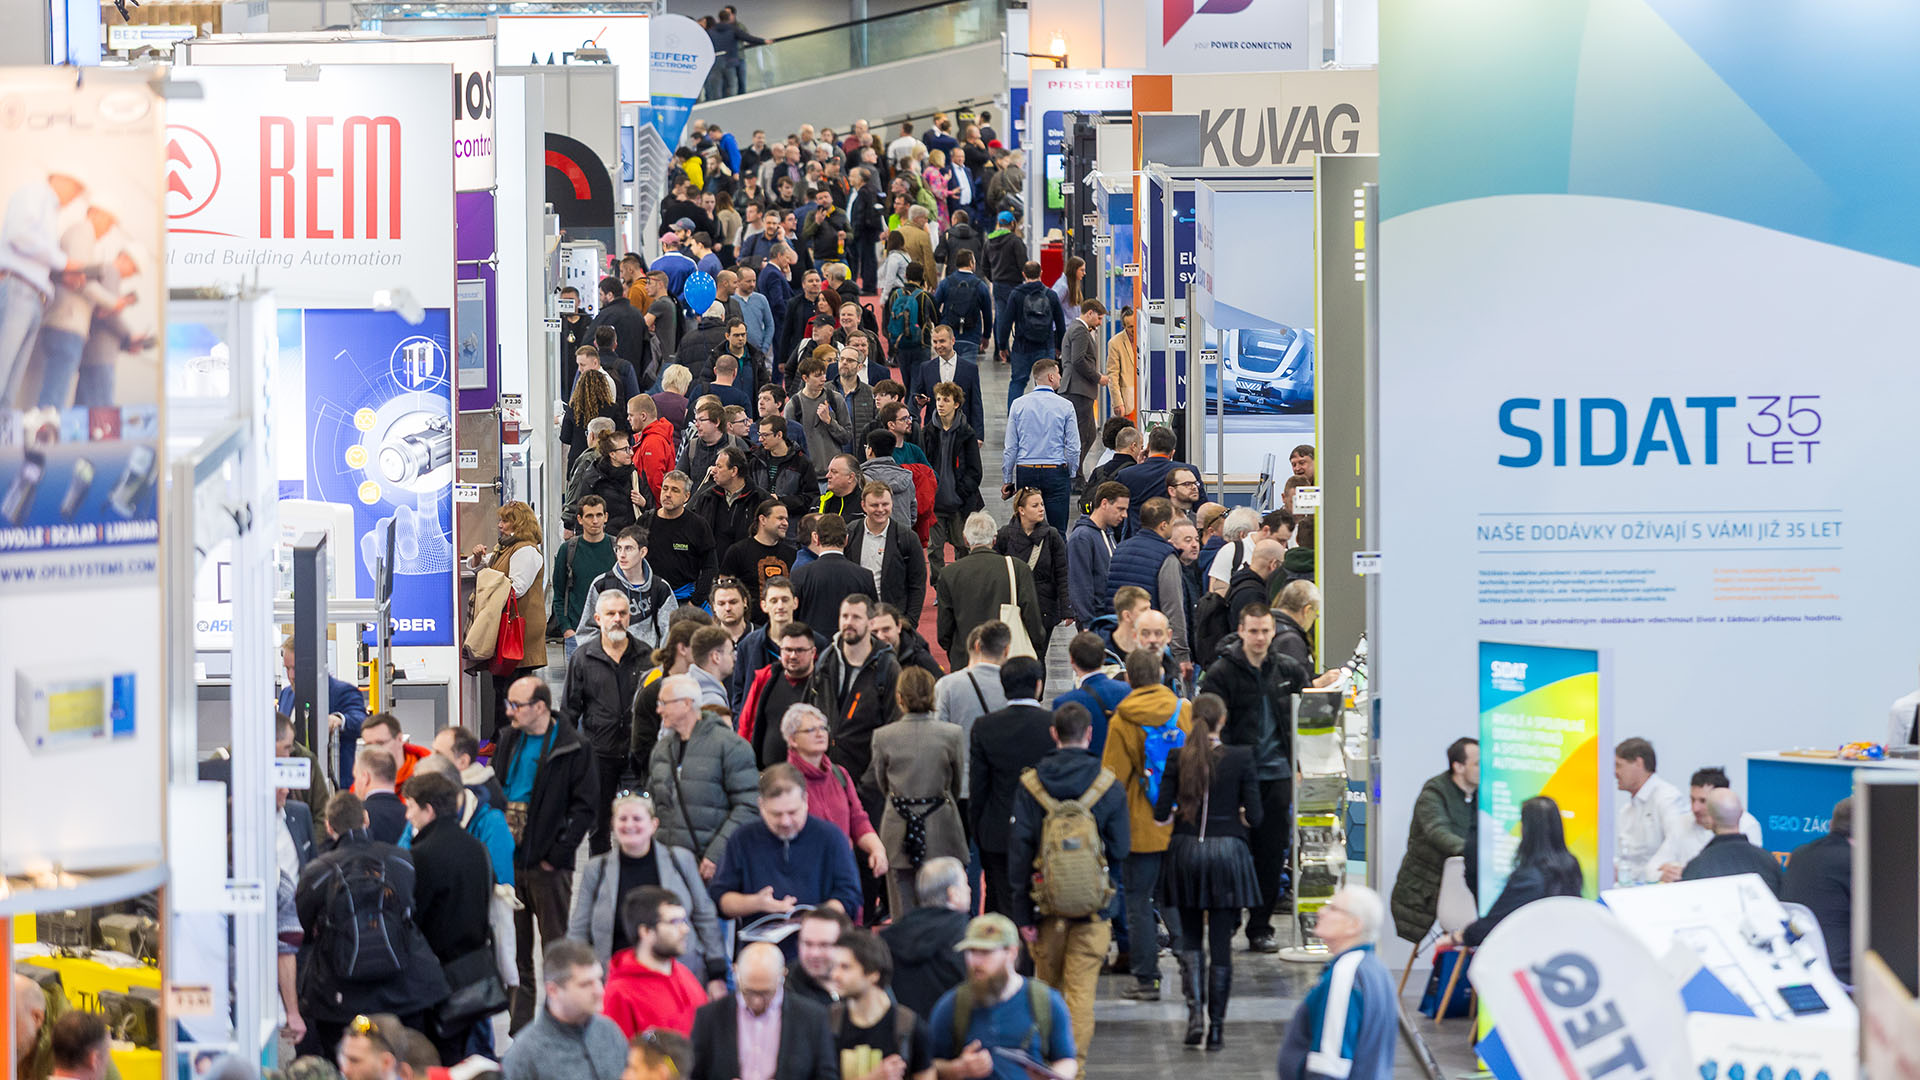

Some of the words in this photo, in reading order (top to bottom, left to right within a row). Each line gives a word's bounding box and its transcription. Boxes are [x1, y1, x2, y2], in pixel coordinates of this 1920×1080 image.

[1210, 41, 1239, 49] POWER
[1240, 41, 1292, 50] CONNECTION
[1200, 103, 1360, 167] KUVAG
[260, 116, 401, 239] REM
[184, 249, 216, 265] and
[222, 248, 294, 269] Building
[300, 250, 402, 266] Automation
[1498, 396, 1737, 468] SIDAT
[1747, 395, 1822, 437] 35
[1747, 441, 1821, 464] LET
[1477, 522, 1526, 541] NAŠE
[1531, 521, 1616, 541] DODÁVKY
[1621, 520, 1687, 542] OŽÍVAJÍ
[1692, 522, 1702, 540] S
[1707, 520, 1753, 539] VÁMI
[1758, 519, 1781, 541] JIŽ
[1785, 522, 1806, 539] 35
[1811, 520, 1843, 538] LET
[1768, 815, 1800, 832] 520
